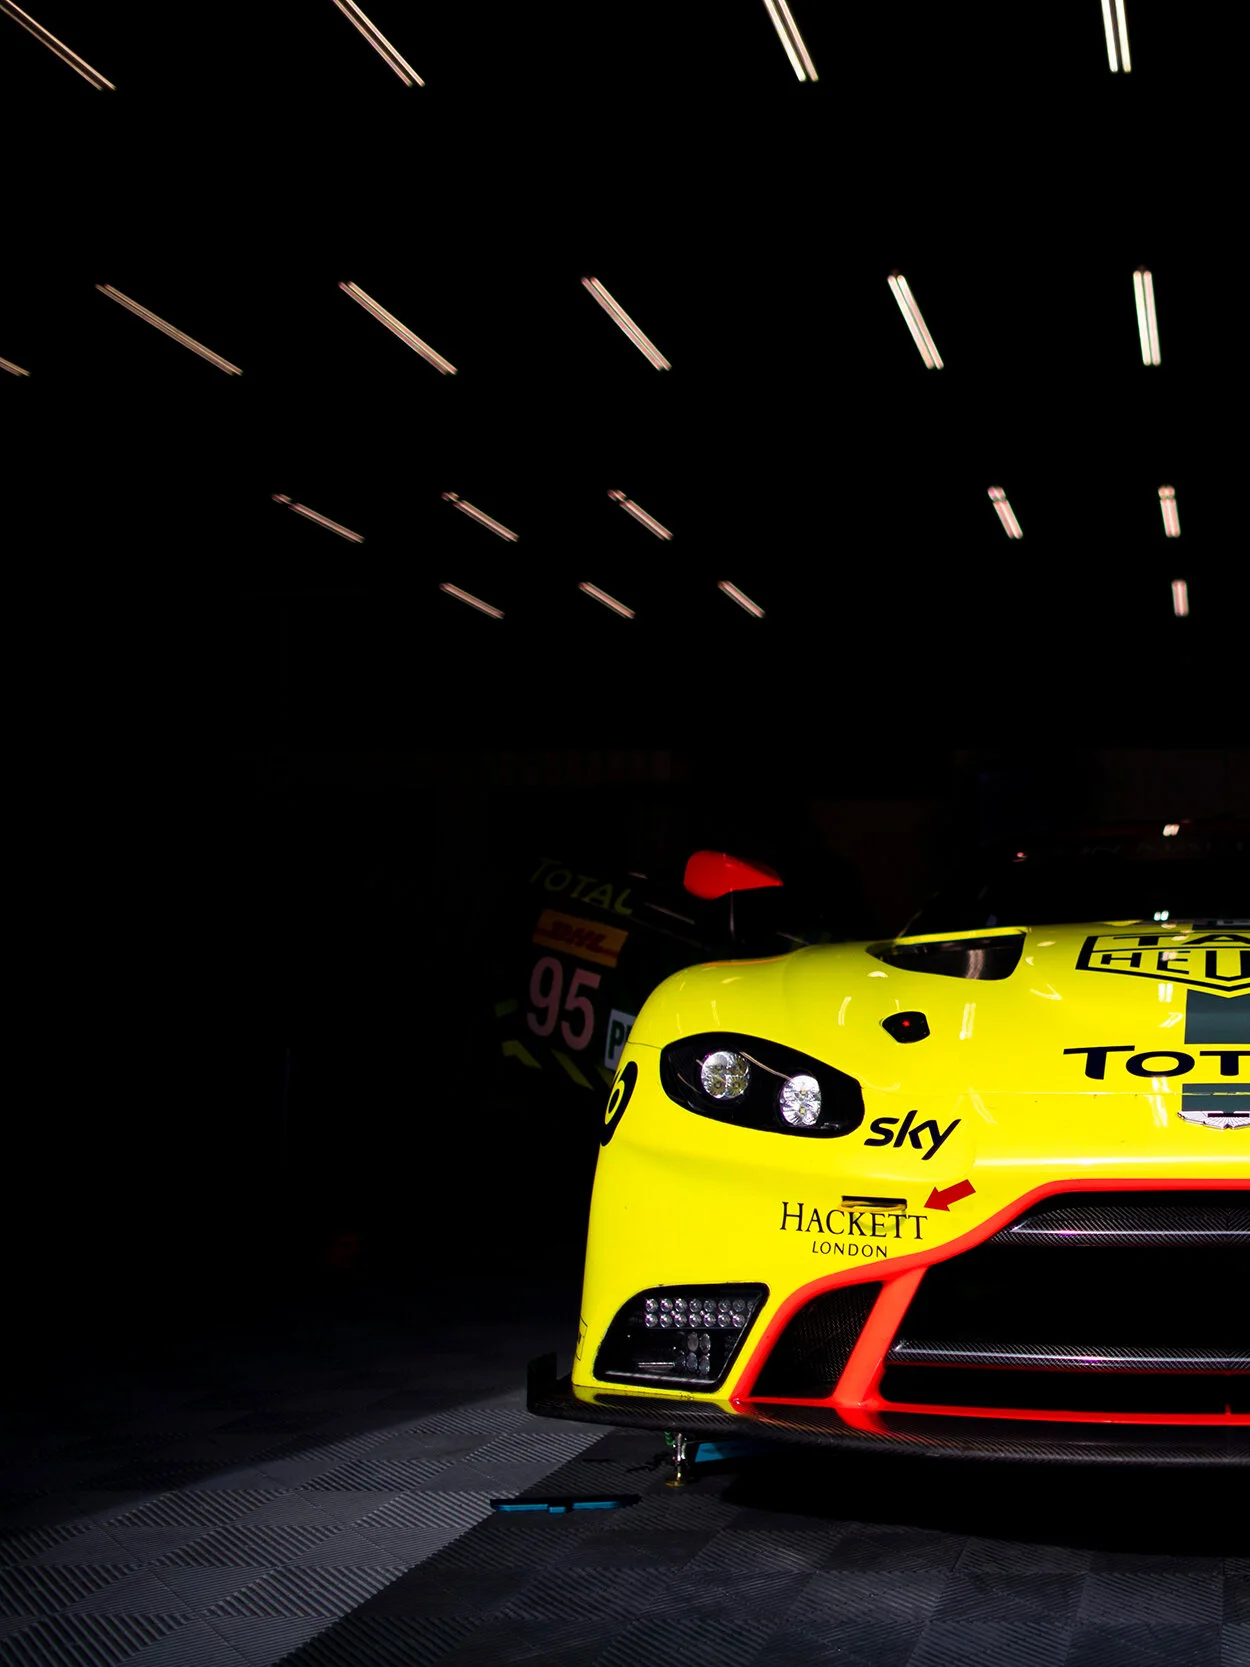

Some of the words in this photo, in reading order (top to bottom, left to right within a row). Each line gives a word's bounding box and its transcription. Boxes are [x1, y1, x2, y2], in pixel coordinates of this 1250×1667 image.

[528, 856, 635, 917] TOTAL
[550, 921, 607, 953] DHL
[525, 954, 602, 1052] 95
[863, 1109, 962, 1161] sky
[779, 1201, 928, 1240] HACKETT
[811, 1240, 888, 1258] LONDON
